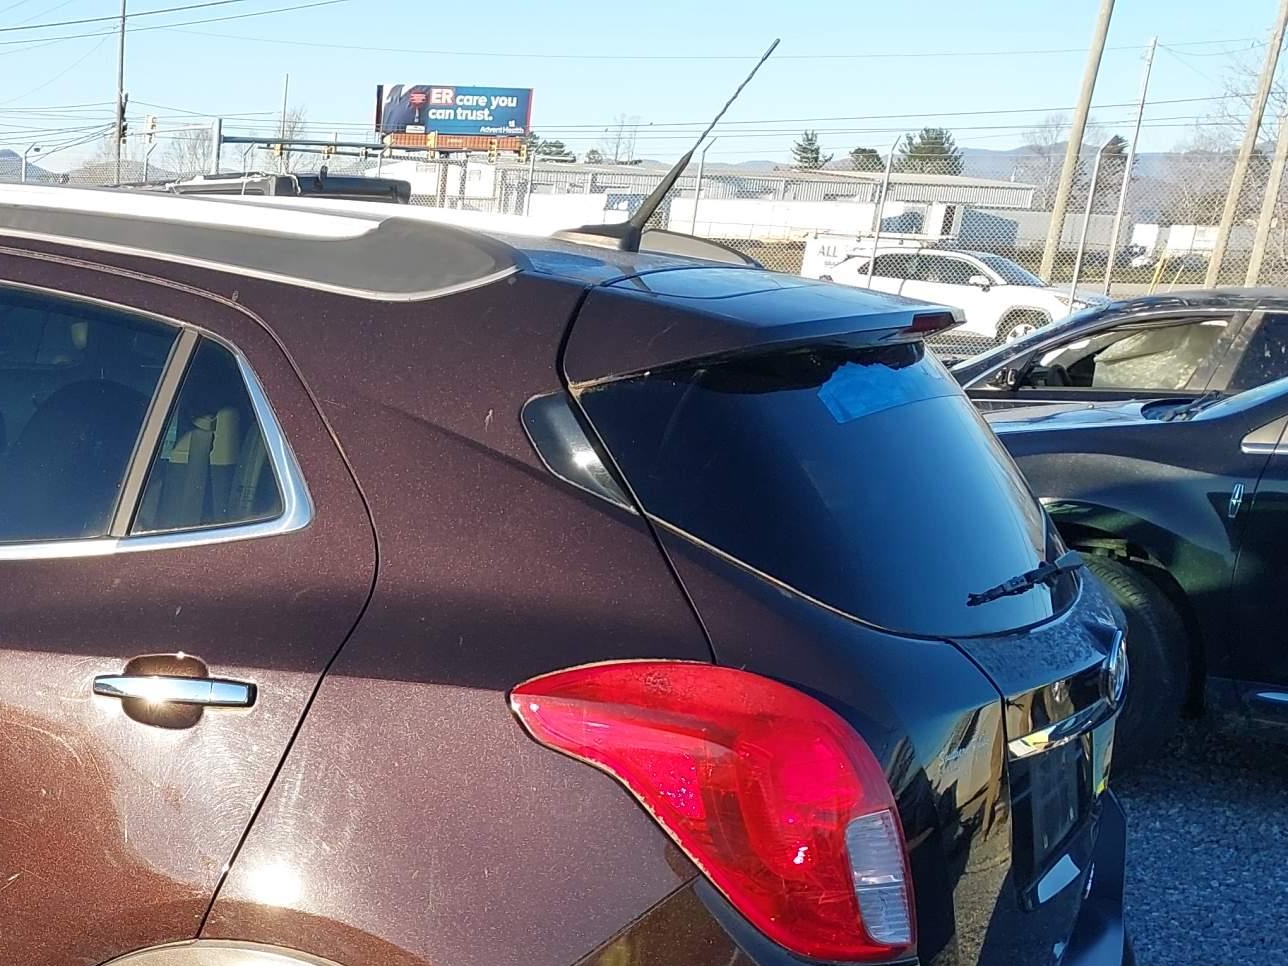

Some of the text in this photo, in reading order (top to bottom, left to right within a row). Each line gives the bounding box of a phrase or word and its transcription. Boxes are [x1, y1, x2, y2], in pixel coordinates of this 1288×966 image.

[431, 88, 517, 109] ER care you
[428, 107, 493, 121] can trust.
